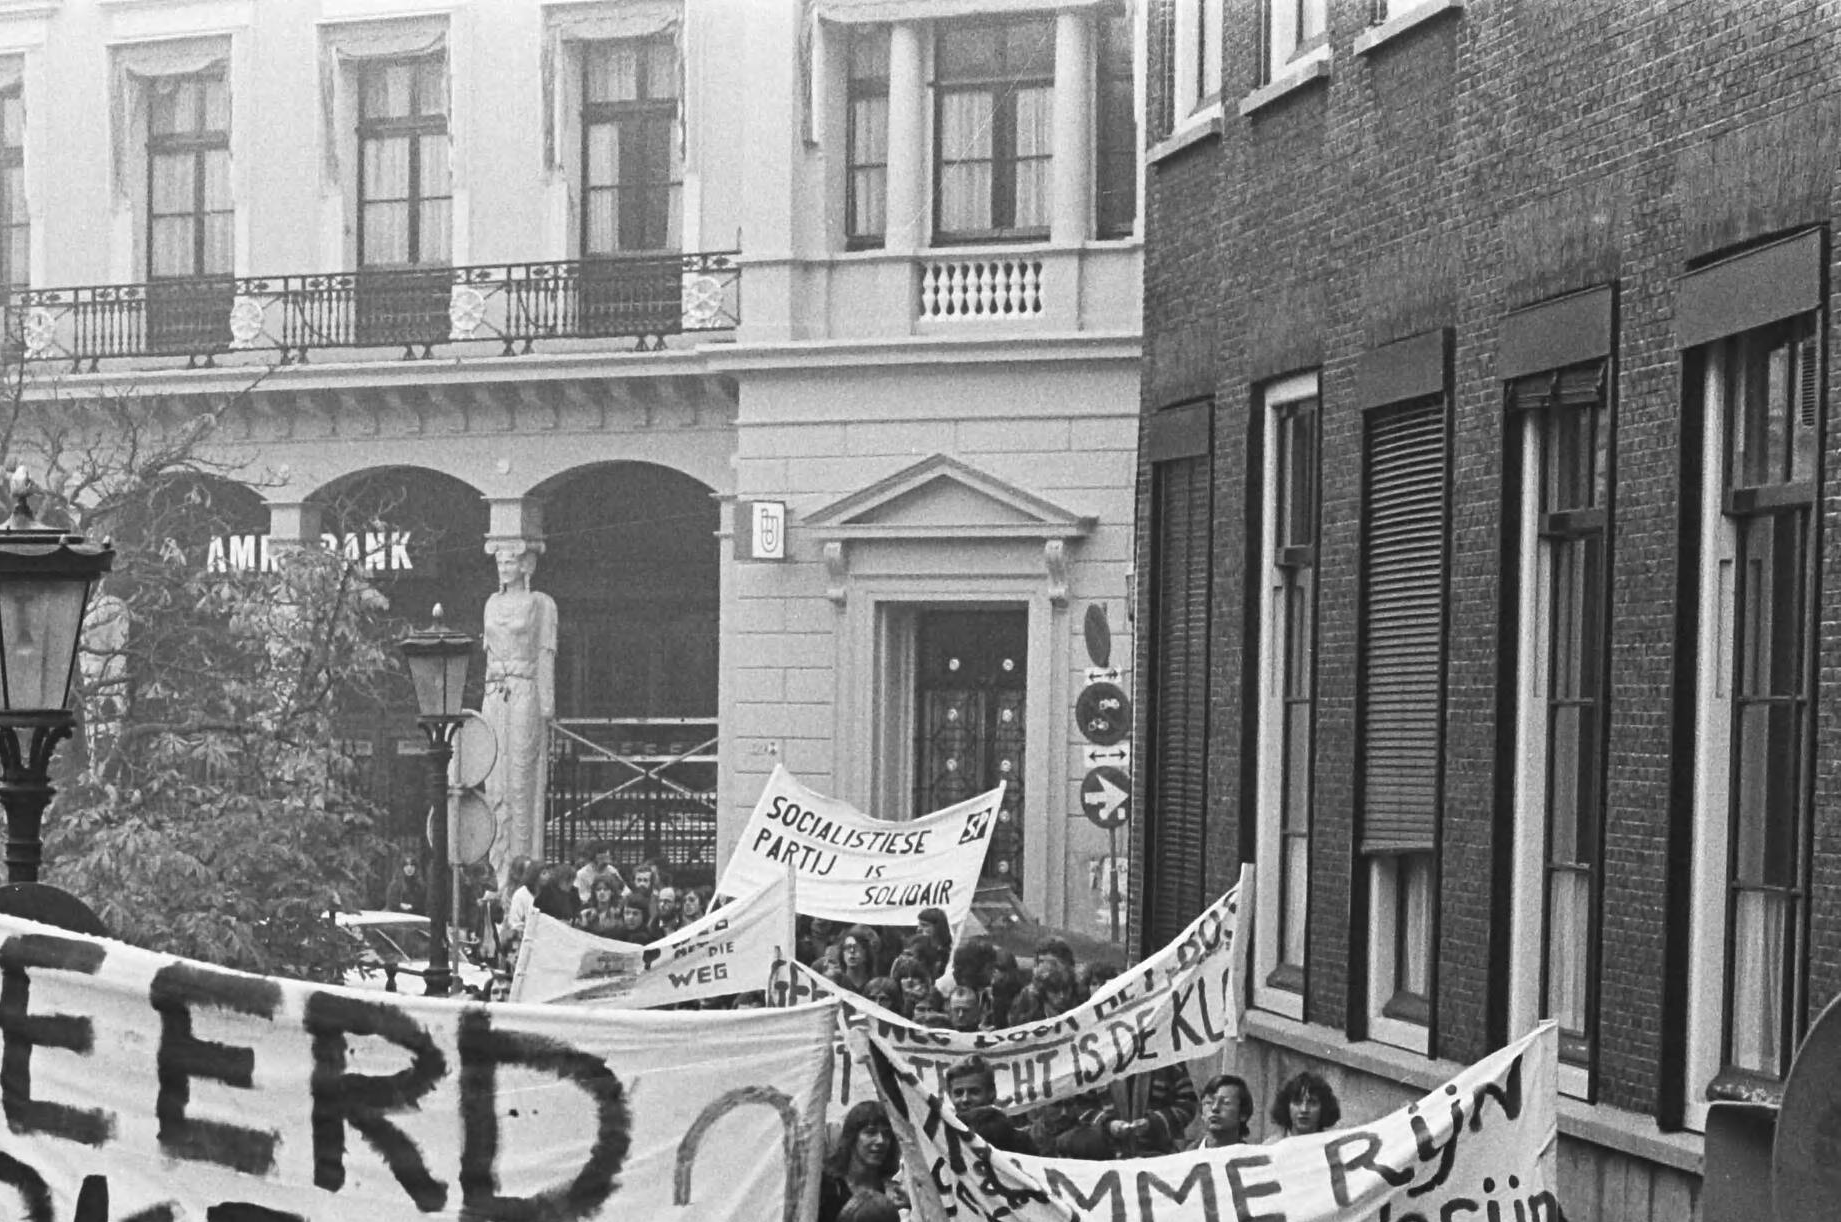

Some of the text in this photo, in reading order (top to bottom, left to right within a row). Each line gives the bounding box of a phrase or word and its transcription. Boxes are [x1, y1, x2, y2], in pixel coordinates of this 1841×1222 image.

[207, 535, 279, 572] AMR
[766, 796, 932, 854] SOCIALISTIESE
[753, 827, 838, 876] PARTIJ
[859, 879, 953, 906] SOLIDAIR
[708, 941, 735, 957] DIE
[668, 963, 729, 988] WEG
[1070, 1033, 1106, 1087] IS
[1107, 1007, 1159, 1076] DE
